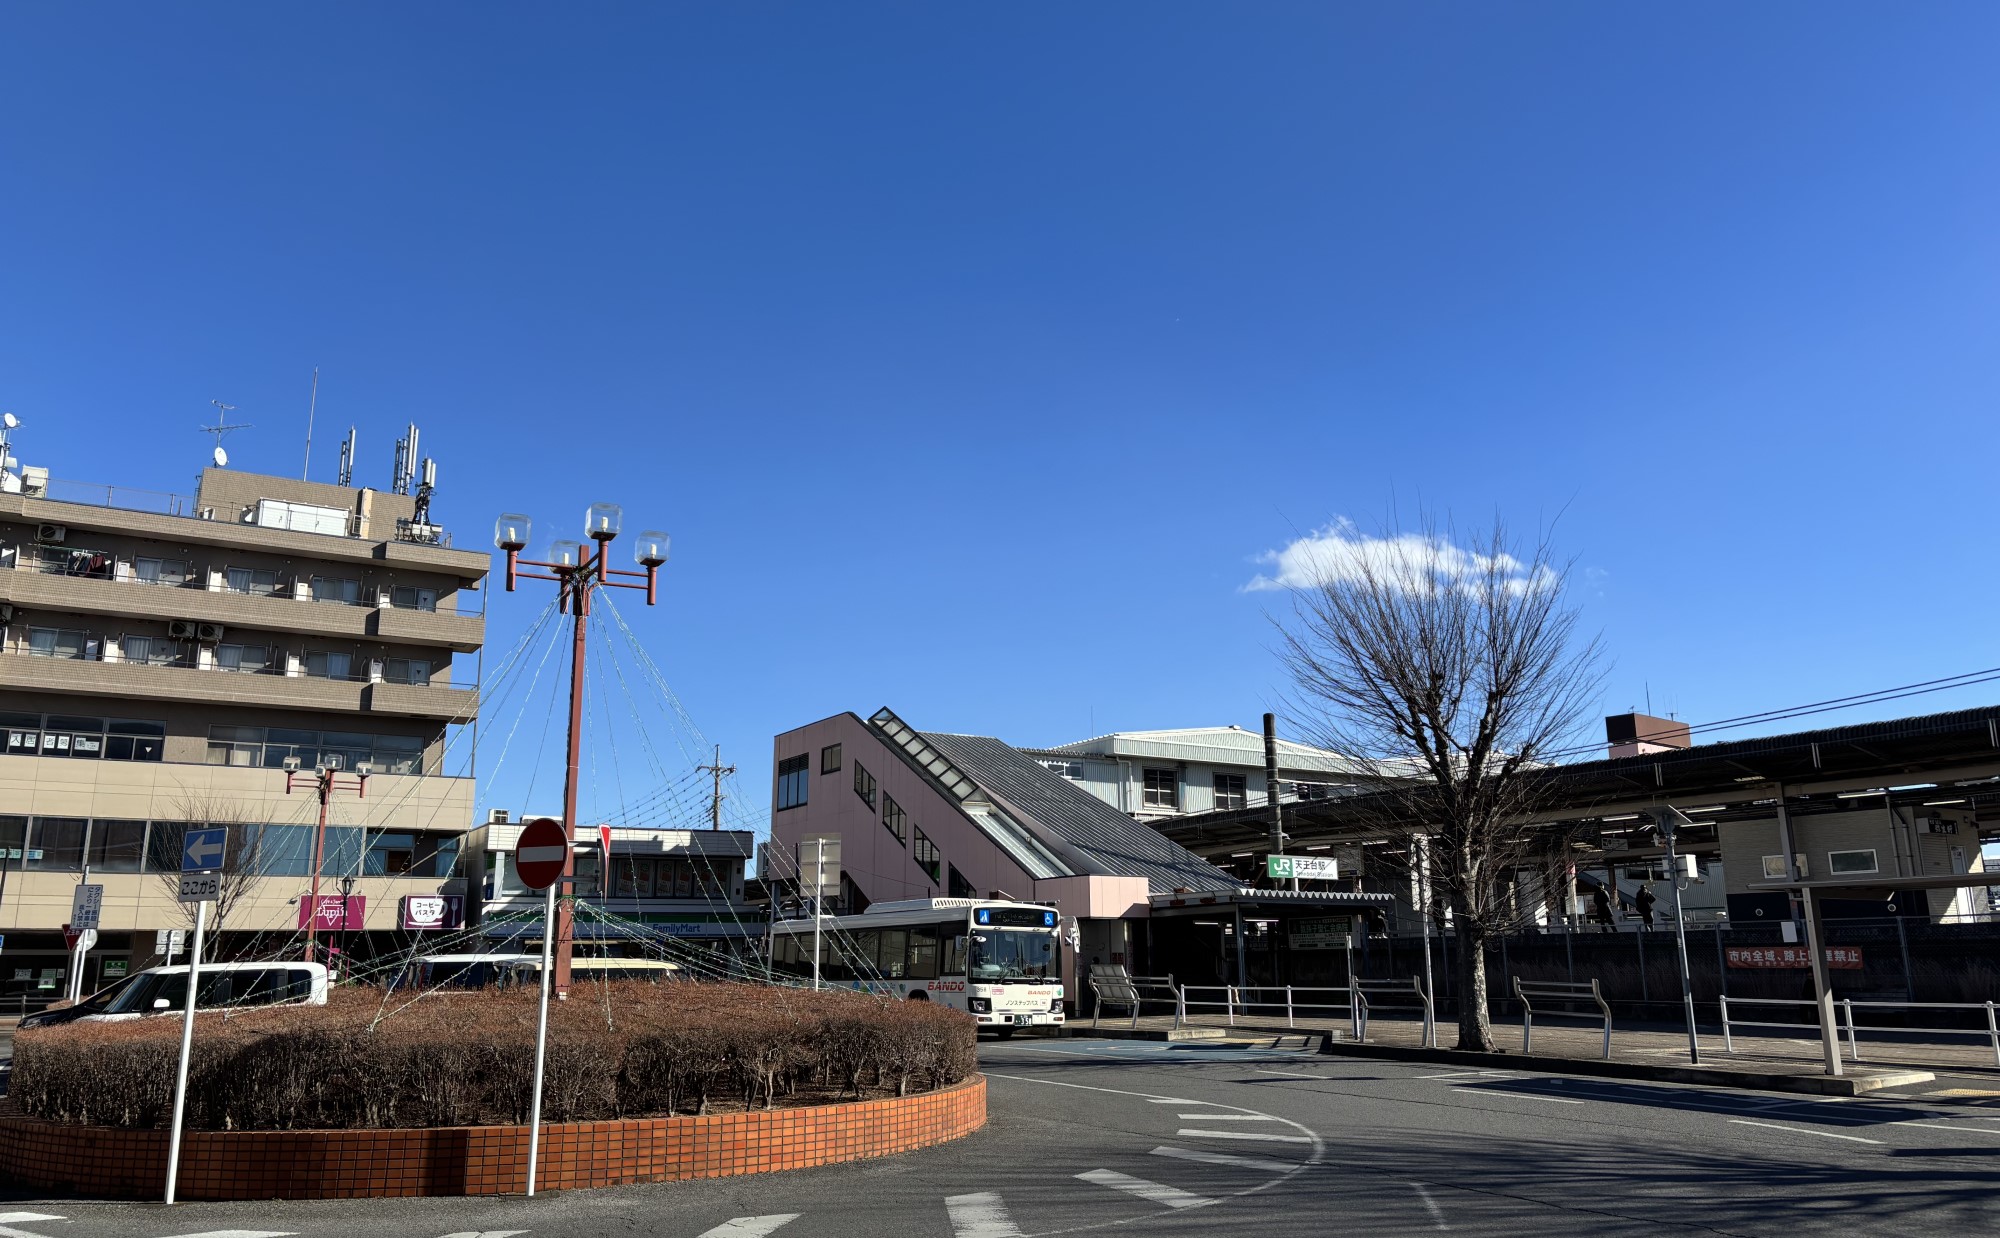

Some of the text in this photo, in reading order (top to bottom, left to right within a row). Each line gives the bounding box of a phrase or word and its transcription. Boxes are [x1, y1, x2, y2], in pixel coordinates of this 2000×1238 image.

[1274, 859, 1290, 871] JR
[1295, 860, 1326, 871] 天王台駅
[181, 880, 217, 895] ここから
[316, 907, 348, 918] Lupin
[652, 923, 701, 935] FamilyMart
[1728, 950, 1860, 962] 市内全域、路上煙禁止
[927, 981, 965, 992] BANDO
